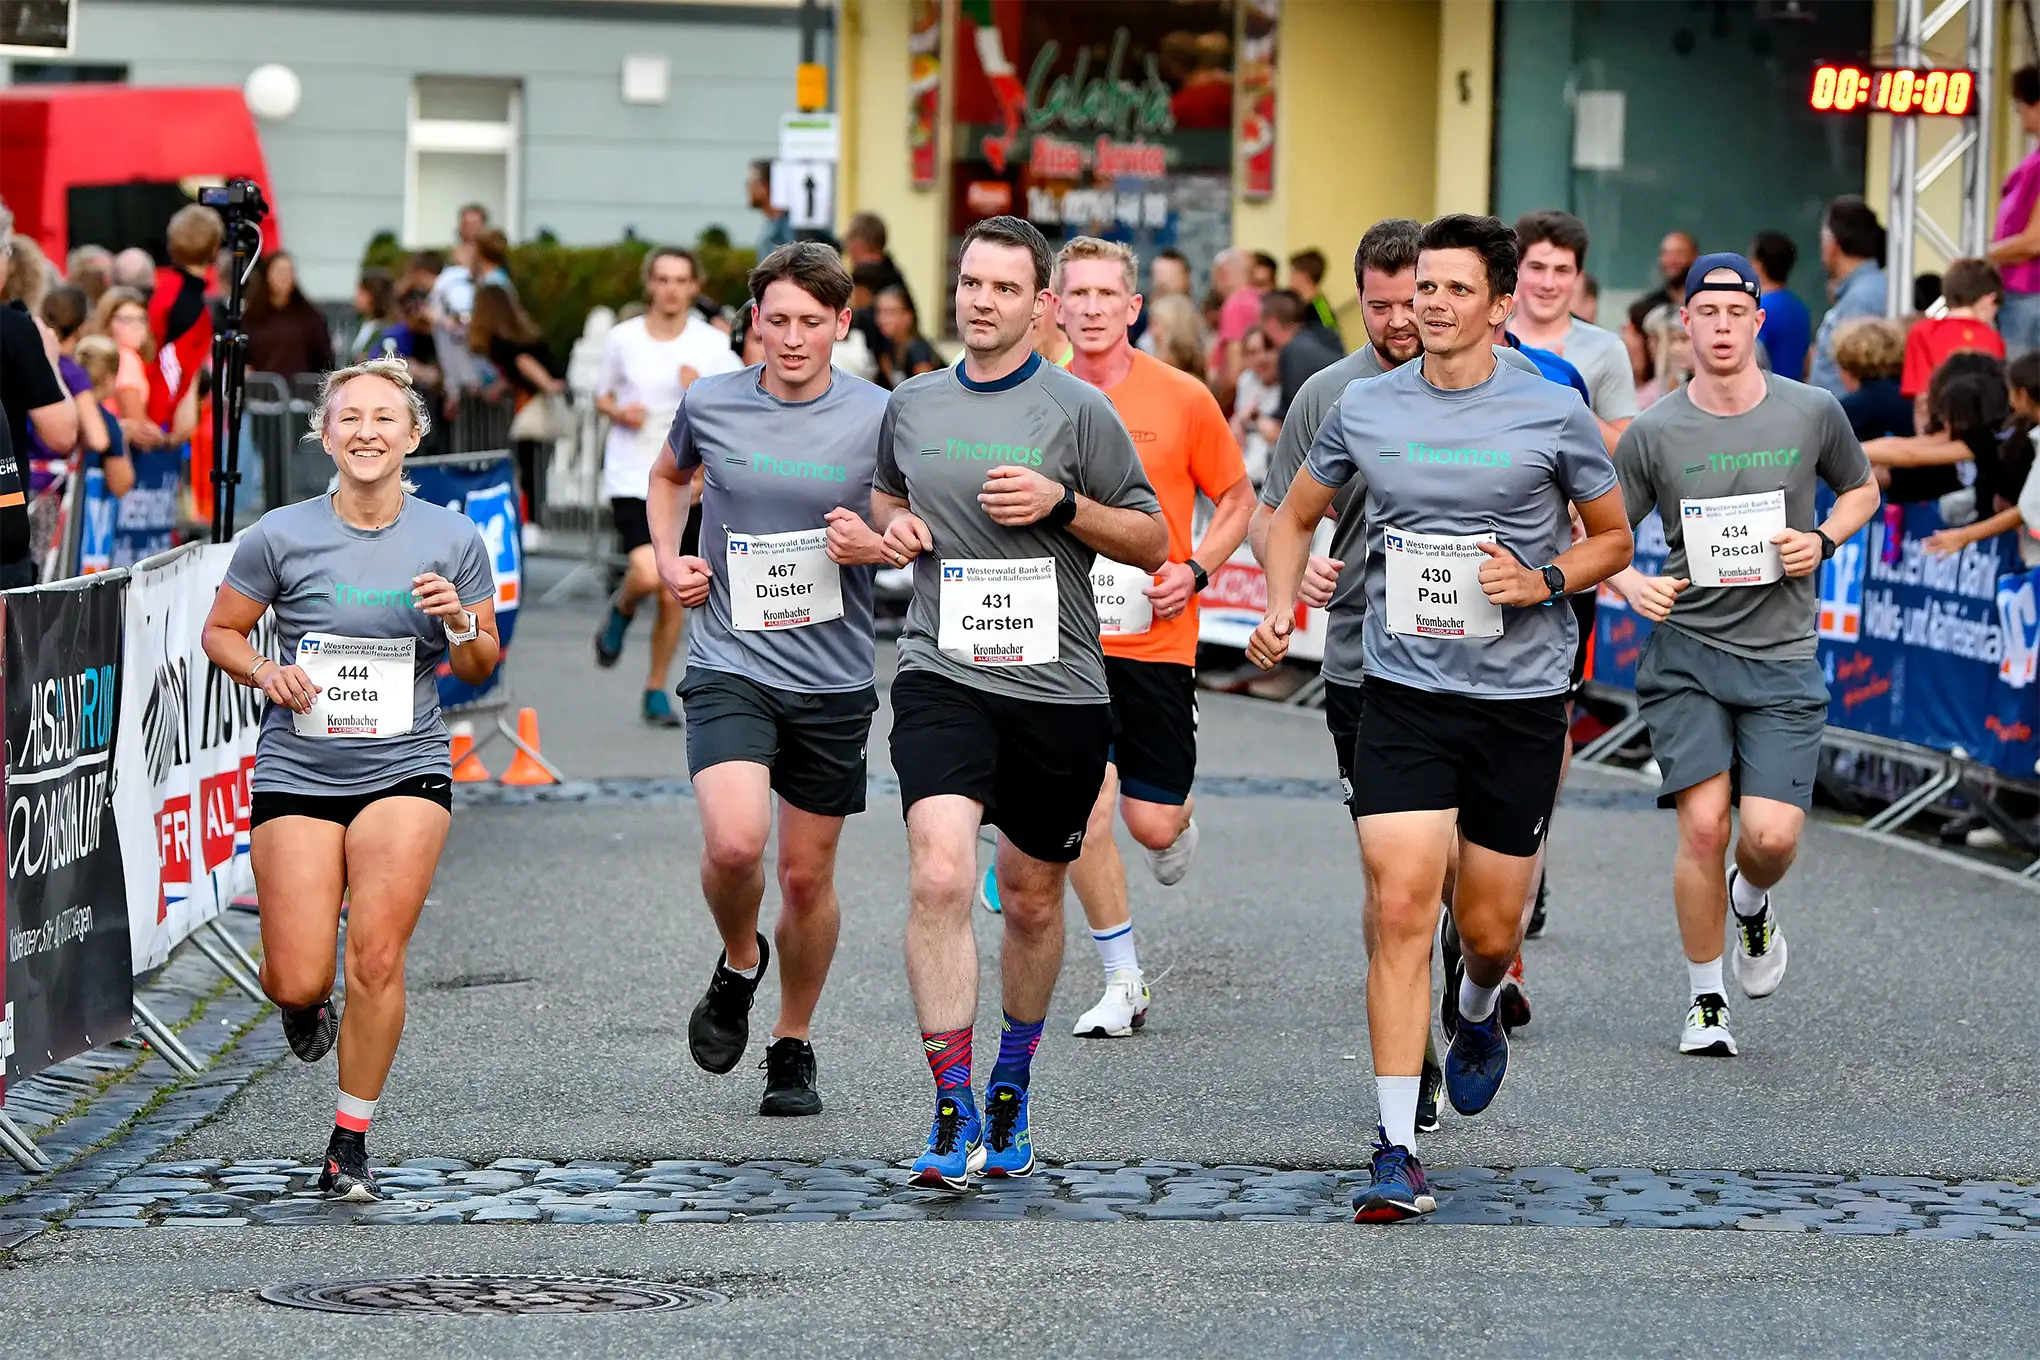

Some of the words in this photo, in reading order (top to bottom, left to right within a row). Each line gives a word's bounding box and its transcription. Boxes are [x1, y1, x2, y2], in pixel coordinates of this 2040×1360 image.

[1811, 65, 1972, 115] 00:10:00
[945, 437, 1043, 467] Thomas
[1406, 442, 1511, 468] Thomas
[1708, 447, 1800, 473] Thomas
[751, 452, 847, 483] Thomas
[1722, 525, 1748, 538] 434
[751, 539, 798, 549] Westerwald
[801, 537, 820, 545] Bank
[1405, 539, 1453, 551] Westerwald
[1711, 541, 1764, 557] Pascal
[768, 563, 797, 578] 467
[1019, 566, 1039, 574] Bank
[1041, 565, 1051, 573] eG
[1421, 568, 1452, 583] 430
[1718, 566, 1761, 577] Krombacher
[1003, 573, 1051, 581] Raiffeisenbank
[334, 583, 421, 608] Thoma
[756, 582, 814, 598] Düster
[1418, 587, 1458, 604] Paul
[982, 594, 1011, 608] 431
[1094, 595, 1125, 605] arco
[763, 607, 810, 620] Krombacher
[962, 615, 1033, 630] Carsten
[1416, 614, 1465, 628] Krombacher
[324, 642, 375, 650] Westerwald
[973, 643, 1024, 655] Krombacher
[337, 666, 369, 680] 444
[327, 686, 378, 701] Greta
[327, 714, 378, 726] Krombacher
